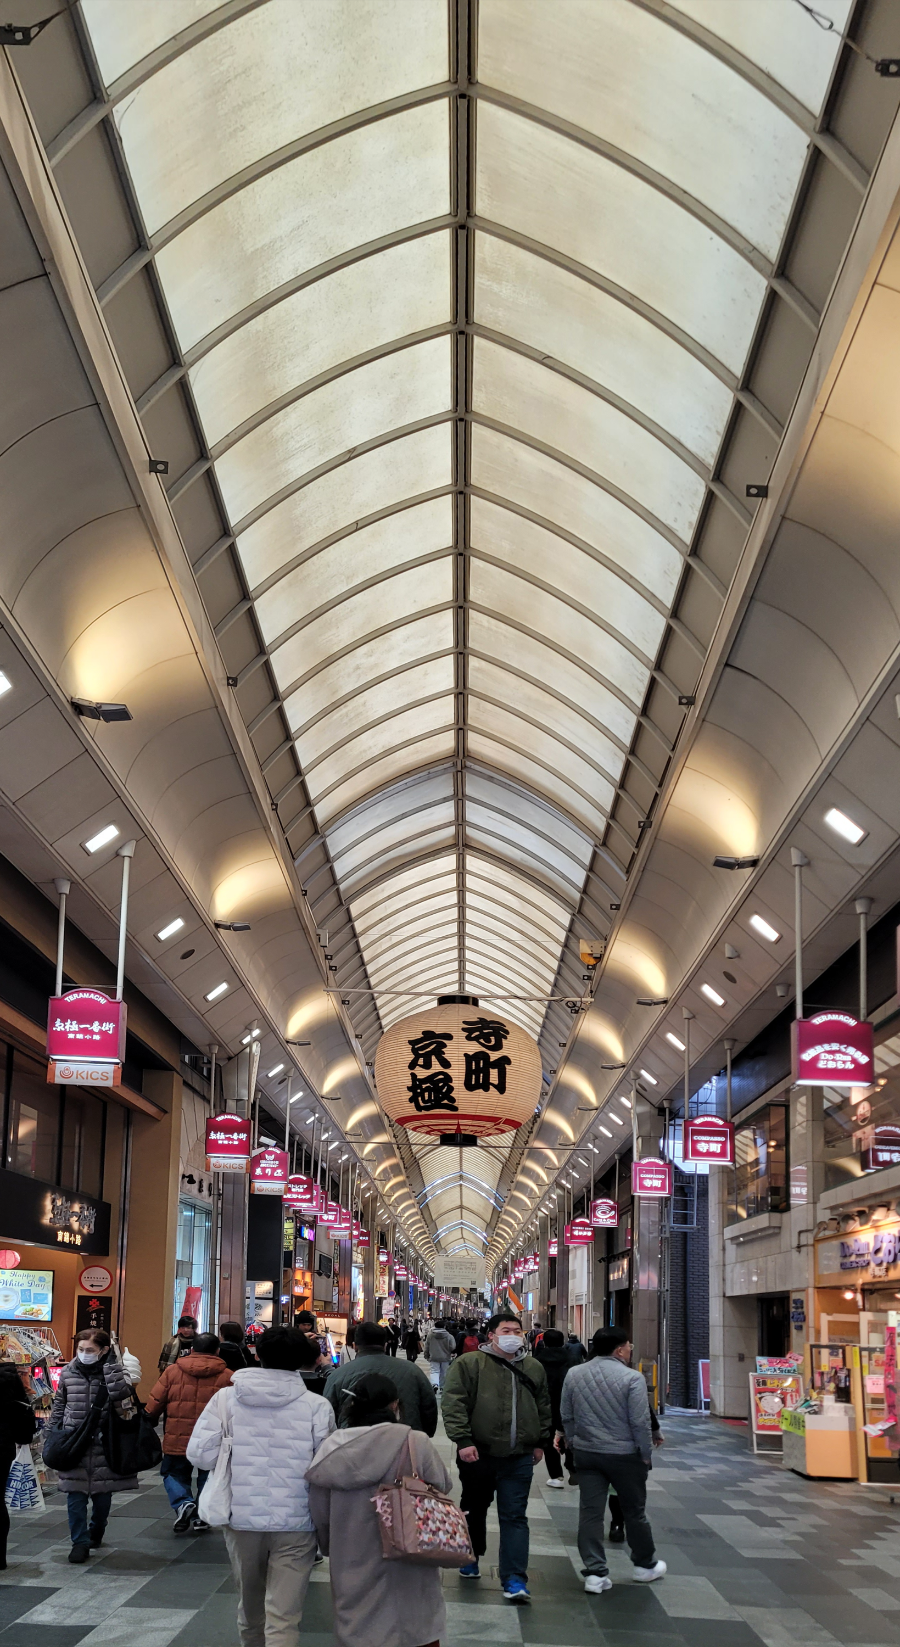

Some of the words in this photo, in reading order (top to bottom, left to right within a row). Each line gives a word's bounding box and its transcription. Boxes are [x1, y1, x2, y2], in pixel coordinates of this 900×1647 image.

[64, 993, 107, 1005] TERAMACHI
[53, 1018, 115, 1034] 京極一番街
[811, 1014, 858, 1027] TERAMACHI
[461, 1017, 511, 1095] 寺町
[75, 1070, 109, 1081] KICS
[407, 1030, 459, 1112] 京極
[696, 1142, 723, 1154] 寺町
[222, 1162, 244, 1170] KICS
[642, 1178, 663, 1188] 寺町
[10, 1271, 36, 1279] Happy
[0, 1279, 25, 1288] White
[27, 1280, 47, 1290] Day
